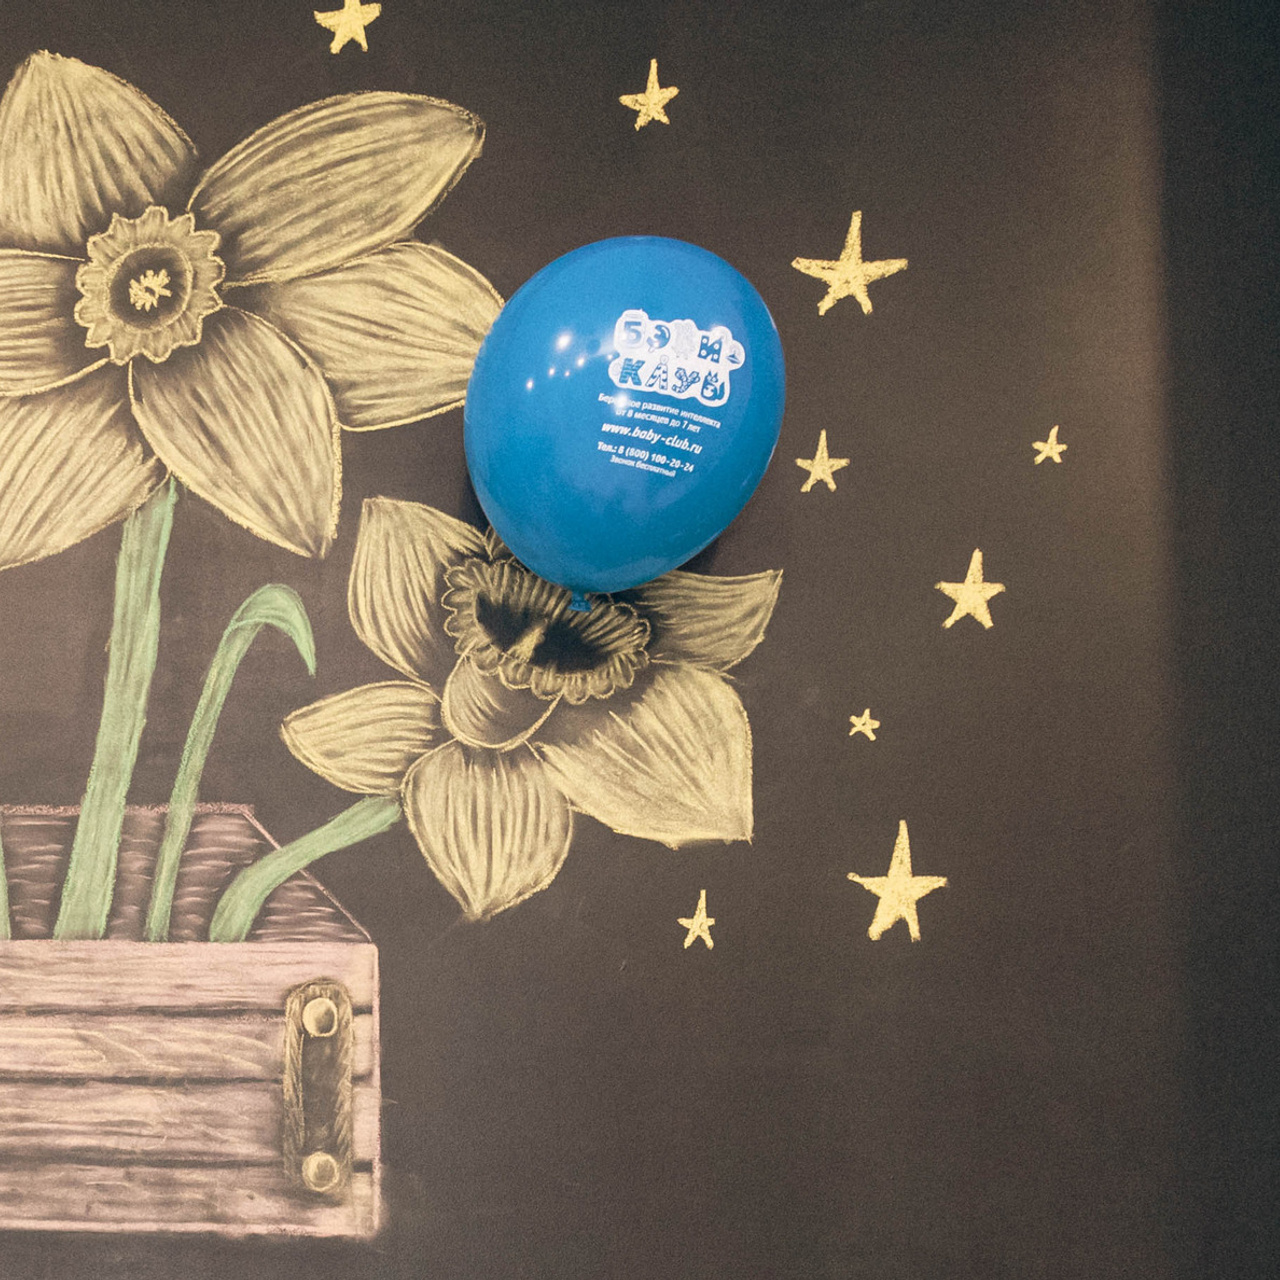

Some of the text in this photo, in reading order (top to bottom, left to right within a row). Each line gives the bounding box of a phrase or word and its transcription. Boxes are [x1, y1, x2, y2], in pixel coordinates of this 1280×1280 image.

[598, 392, 641, 408] Берое
[601, 422, 703, 455] www.baby-club.ru
[650, 452, 696, 474] 100-20-24
